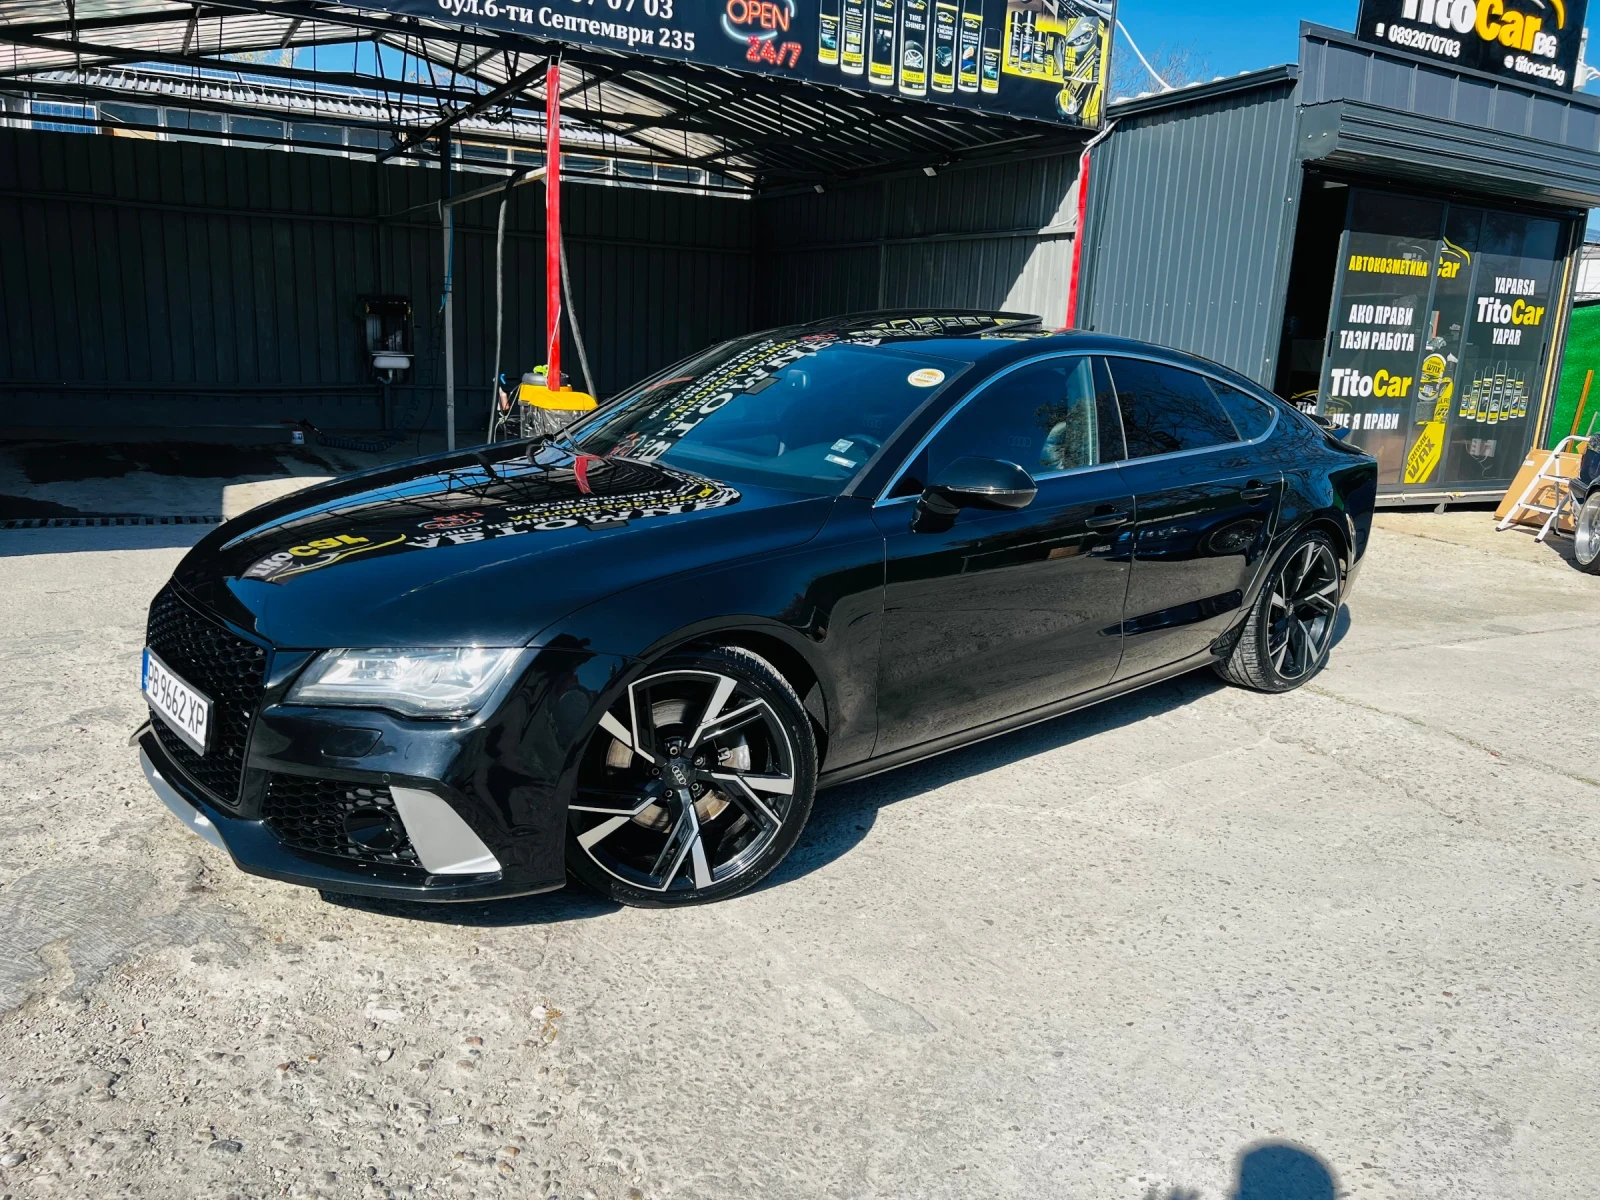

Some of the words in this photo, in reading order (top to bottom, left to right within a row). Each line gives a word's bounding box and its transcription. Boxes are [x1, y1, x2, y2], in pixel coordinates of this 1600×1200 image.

[644, 0, 674, 19] 03
[726, 0, 790, 31] OPEN
[538, 7, 654, 46] Септември
[658, 28, 695, 51] 235
[1388, 25, 1461, 58] 0892070703
[746, 35, 802, 68] 24/7
[1532, 32, 1557, 58] BG
[1515, 55, 1566, 86] titocar.bg
[1348, 255, 1428, 277] АВТОКОЗМЕТИКА
[1494, 277, 1535, 296] YAPARSA
[1348, 304, 1374, 324] АКО
[1374, 305, 1413, 326] ПРАВИ
[1477, 296, 1545, 325] TitoCar
[1340, 330, 1371, 350] ТАЗИ
[1370, 332, 1415, 352] РАБОТА
[1492, 328, 1522, 345] YAPAR
[1331, 368, 1413, 397] TitoCar
[1352, 413, 1361, 430] Я
[1363, 413, 1400, 430] ПРАВИ
[160, 674, 186, 723] 9662
[188, 696, 204, 734] XP
